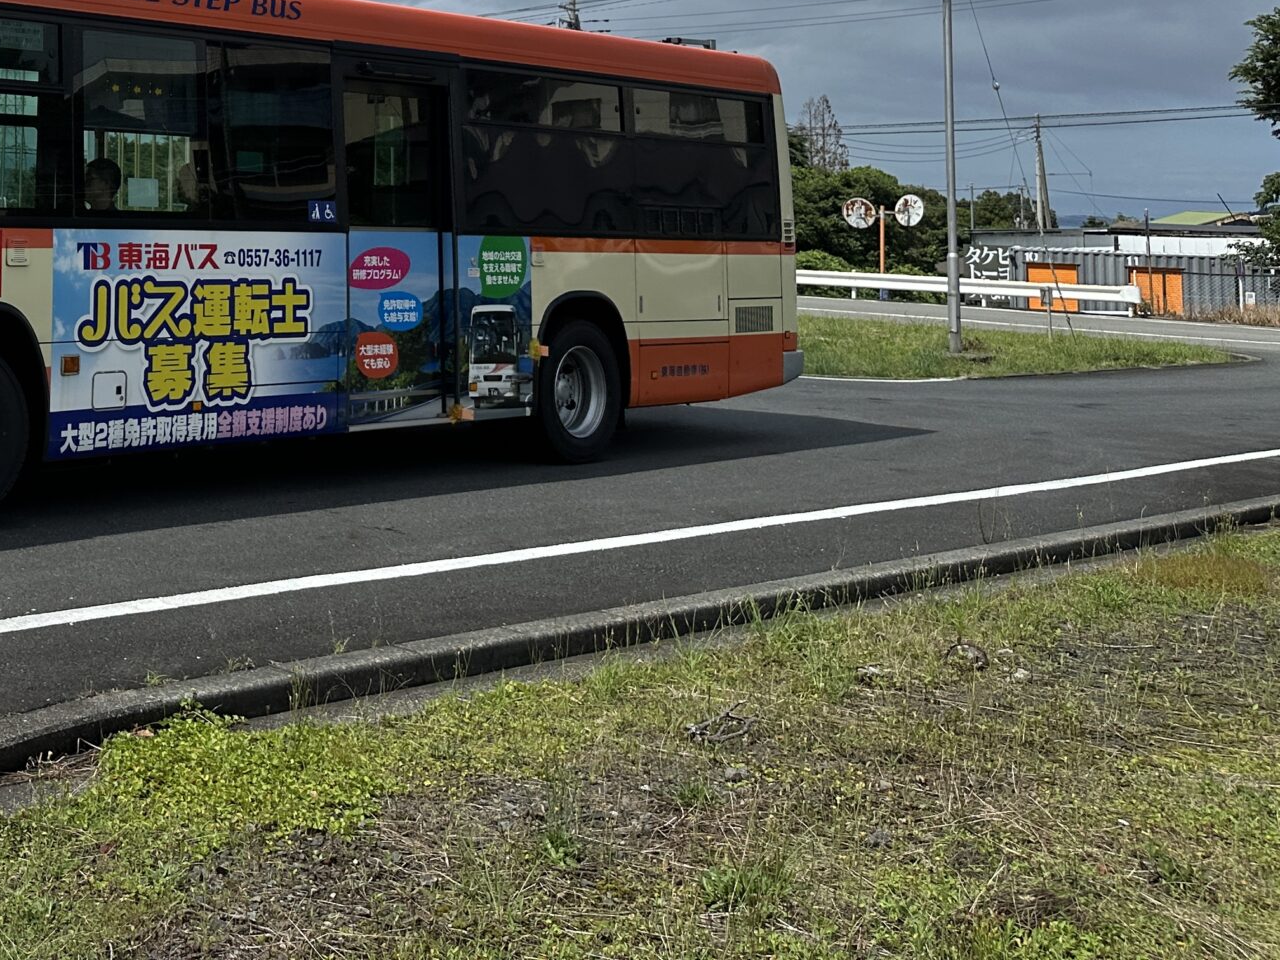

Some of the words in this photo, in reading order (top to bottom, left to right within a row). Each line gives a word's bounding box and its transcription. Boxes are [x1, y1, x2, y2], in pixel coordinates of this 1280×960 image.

[117, 243, 220, 270] 東海バス
[238, 248, 322, 268] 0557-36-1117
[363, 255, 391, 267] 充実した
[1024, 252, 1038, 262] 10
[79, 277, 308, 343] バス運転士
[144, 339, 252, 404] 募集
